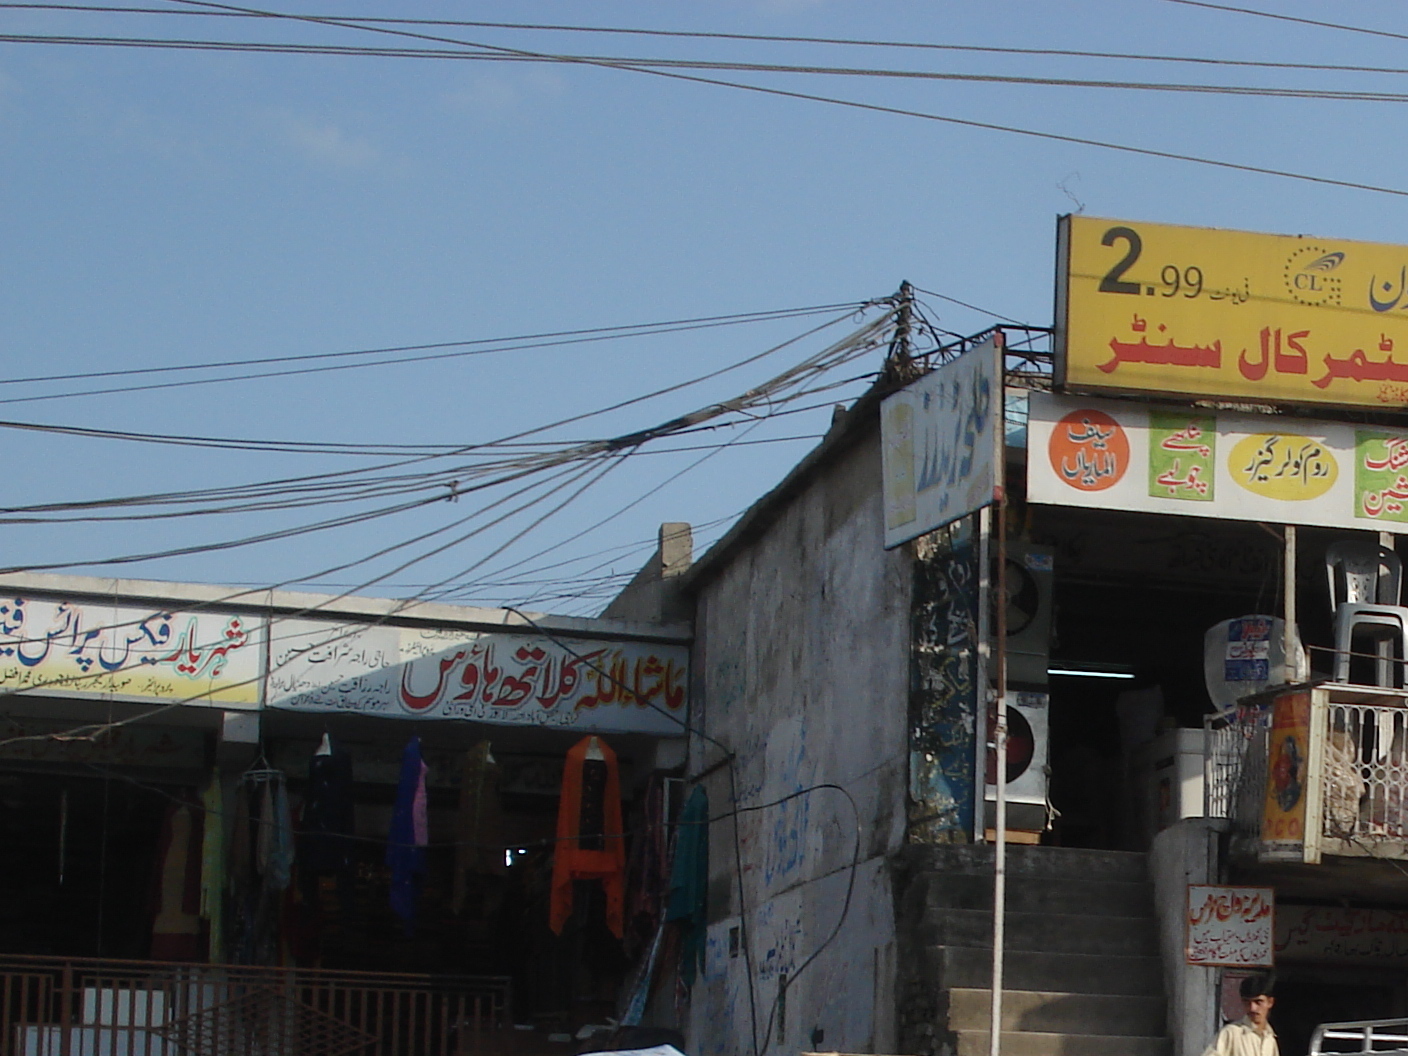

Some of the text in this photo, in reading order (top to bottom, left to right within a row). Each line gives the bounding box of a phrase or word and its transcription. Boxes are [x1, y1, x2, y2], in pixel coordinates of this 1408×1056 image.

[1099, 226, 1204, 299] 2.99
[1293, 273, 1323, 291] CL
[1095, 313, 1222, 374] سنٹر
[1238, 326, 1310, 381] کال
[400, 643, 500, 710] ہاؤس
[489, 642, 609, 709] کلاتھ
